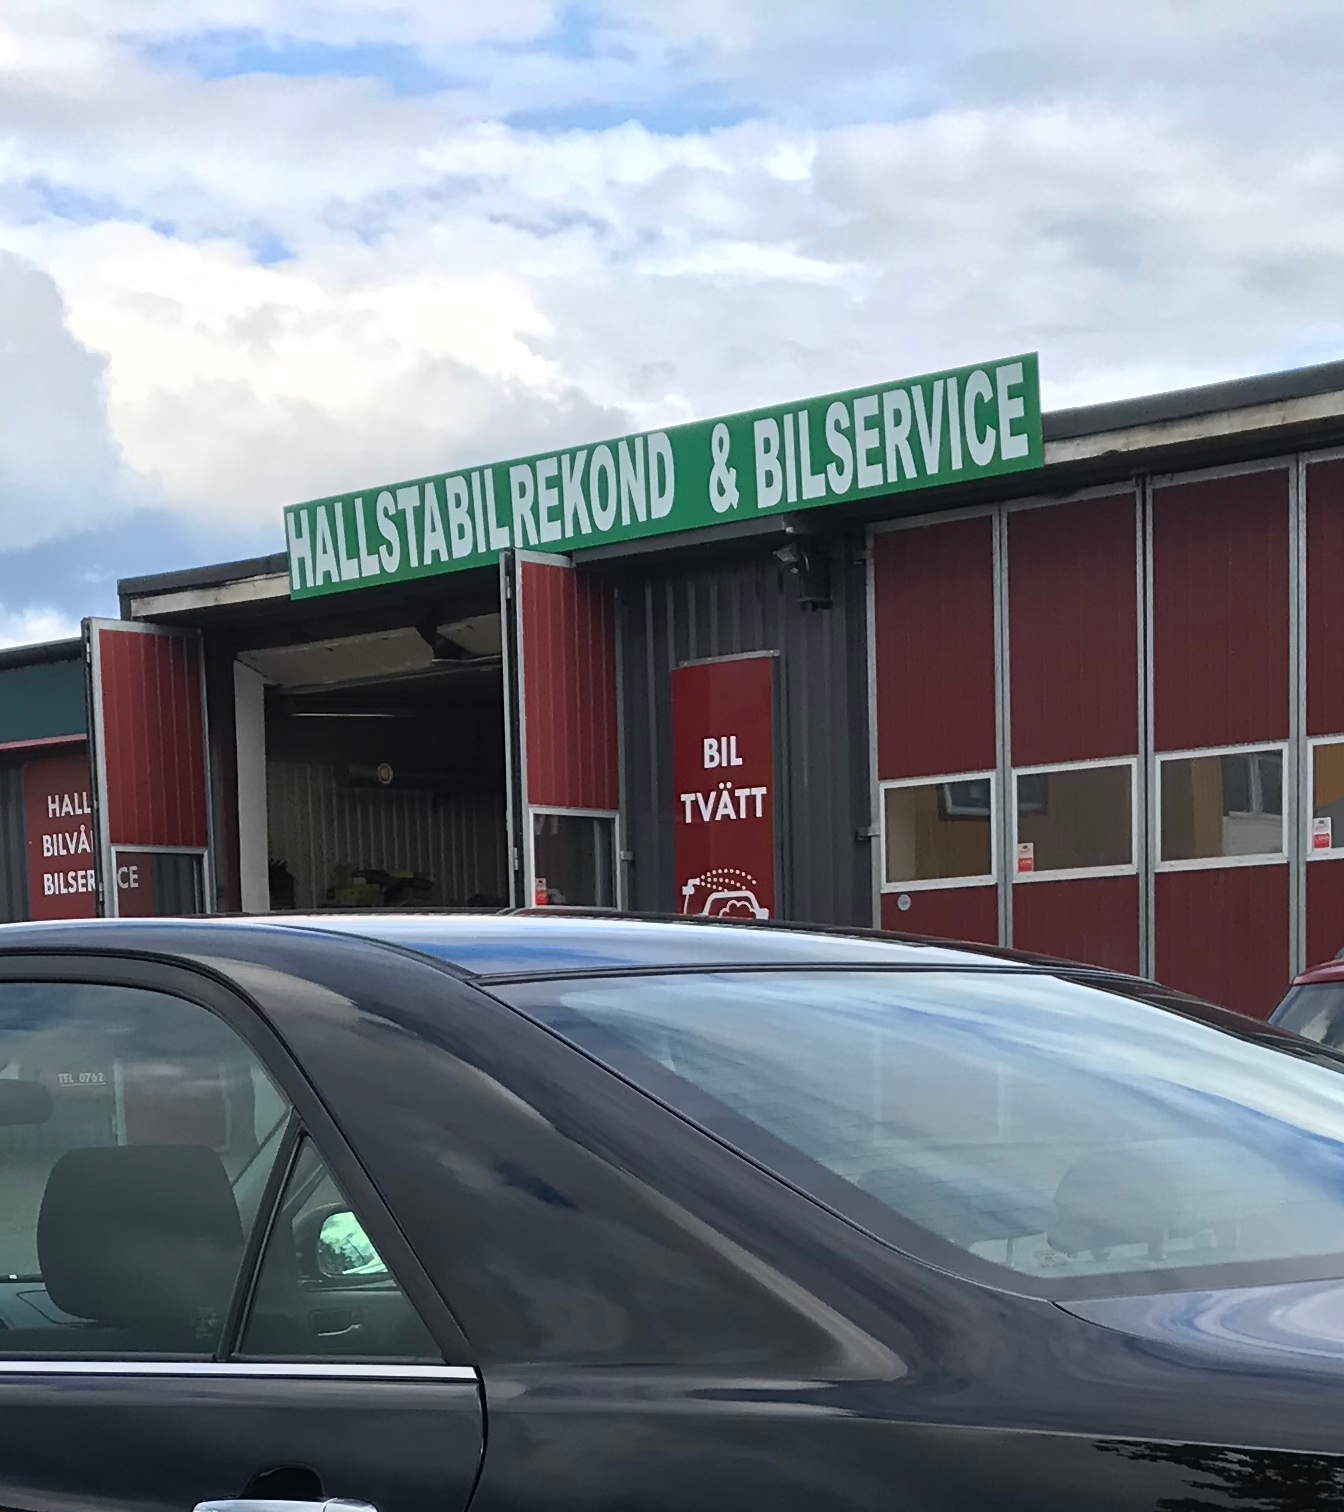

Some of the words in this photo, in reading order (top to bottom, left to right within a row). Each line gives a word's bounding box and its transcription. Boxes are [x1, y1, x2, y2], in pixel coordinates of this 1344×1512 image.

[709, 422, 740, 514] &
[754, 362, 1029, 509] BILSERVICE
[703, 735, 743, 769] BIL
[680, 781, 767, 823] TVÄTT
[42, 824, 94, 857] BILVÅ
[43, 865, 139, 896] BILSERCE
